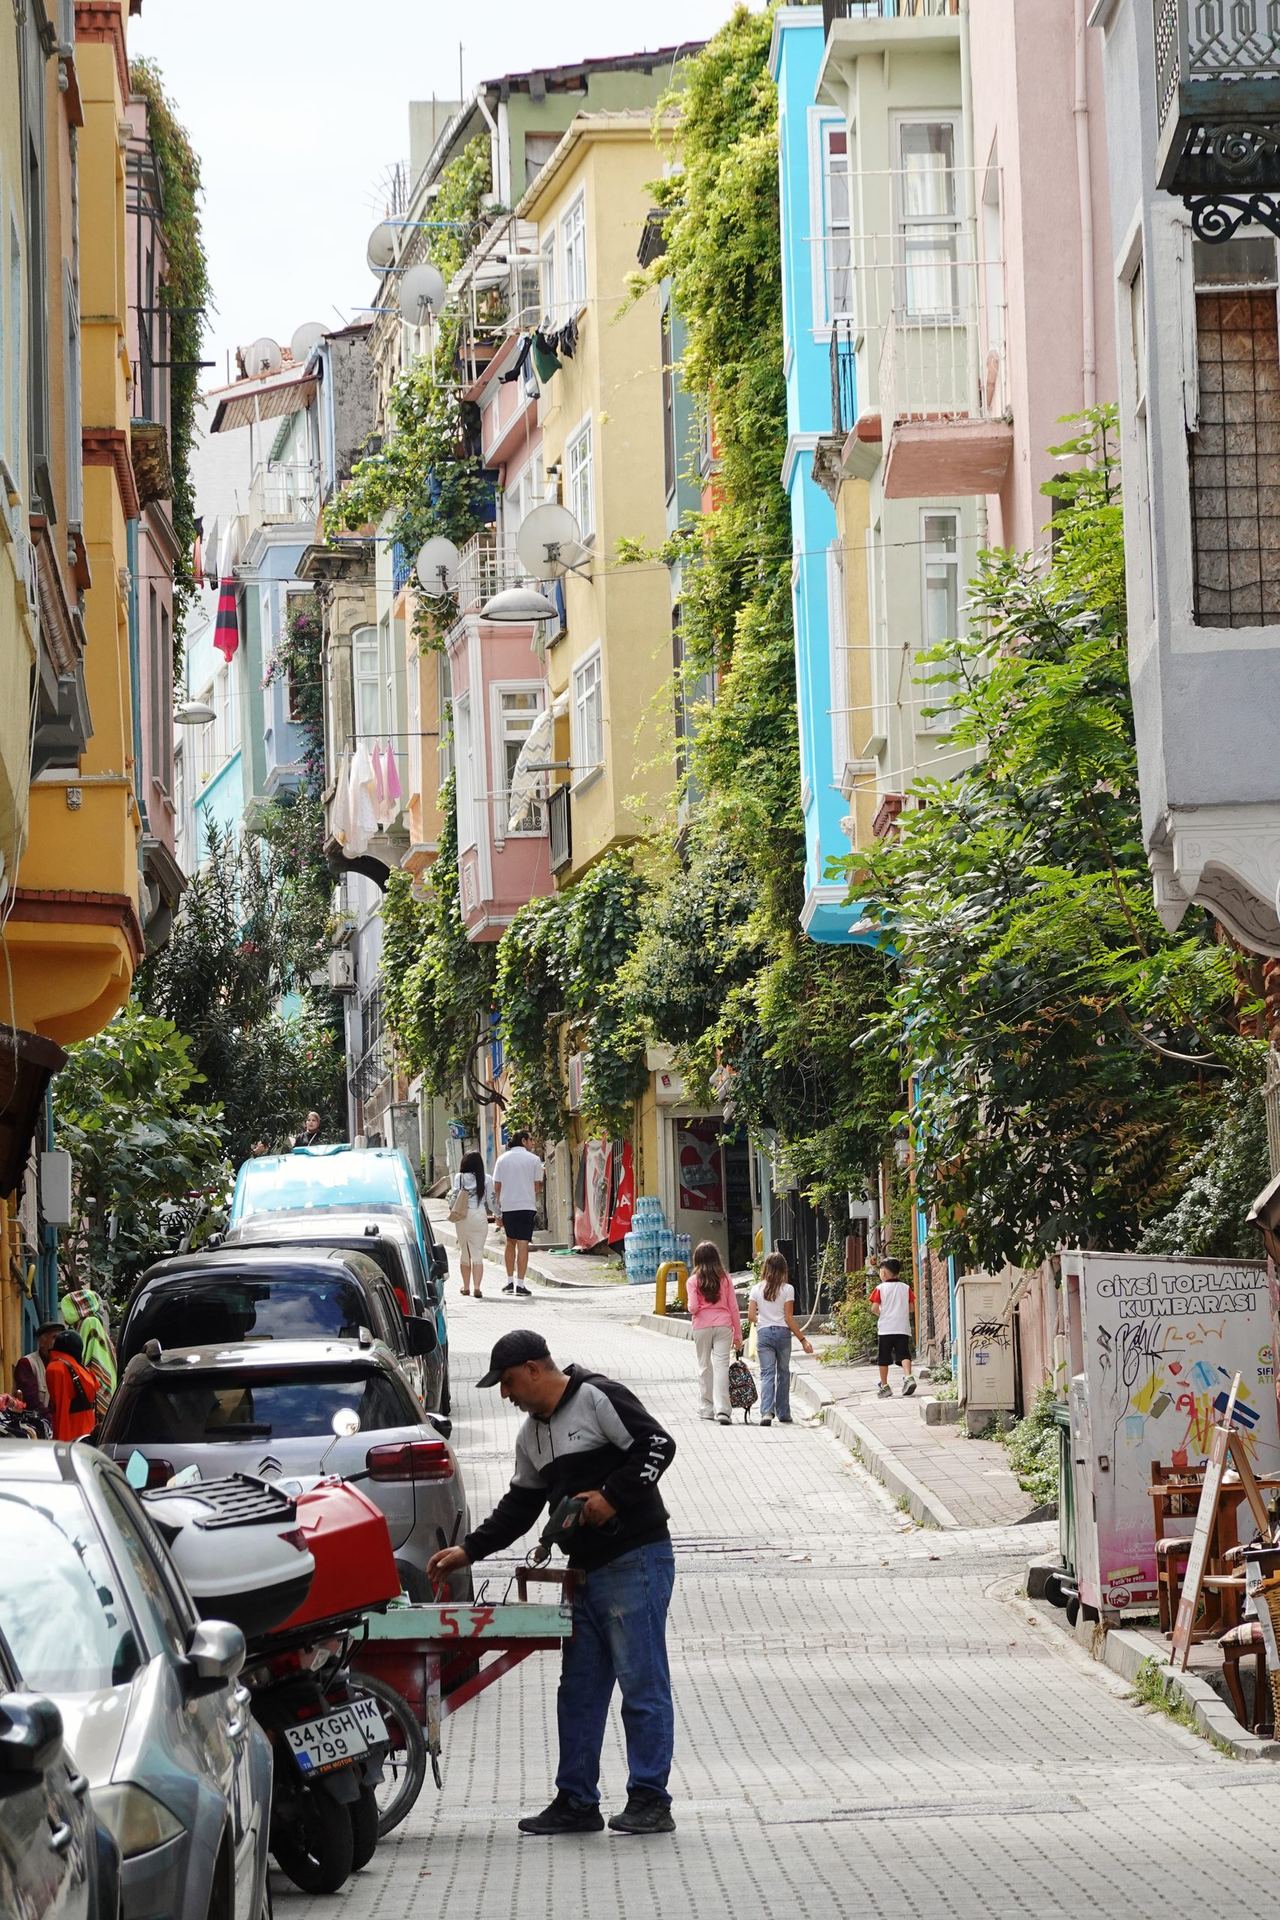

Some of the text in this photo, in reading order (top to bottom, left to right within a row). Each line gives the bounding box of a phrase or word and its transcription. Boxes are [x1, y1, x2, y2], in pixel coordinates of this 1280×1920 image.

[1097, 1271, 1270, 1298] GİYSİ TOPLAMA
[1119, 1293, 1256, 1318] KUMBARASI
[1257, 1367, 1274, 1376] SIFI
[1258, 1376, 1274, 1384] ATI
[439, 1608, 495, 1638] 57
[289, 1714, 355, 1747] 34 KGH
[310, 1738, 348, 1762] 799
